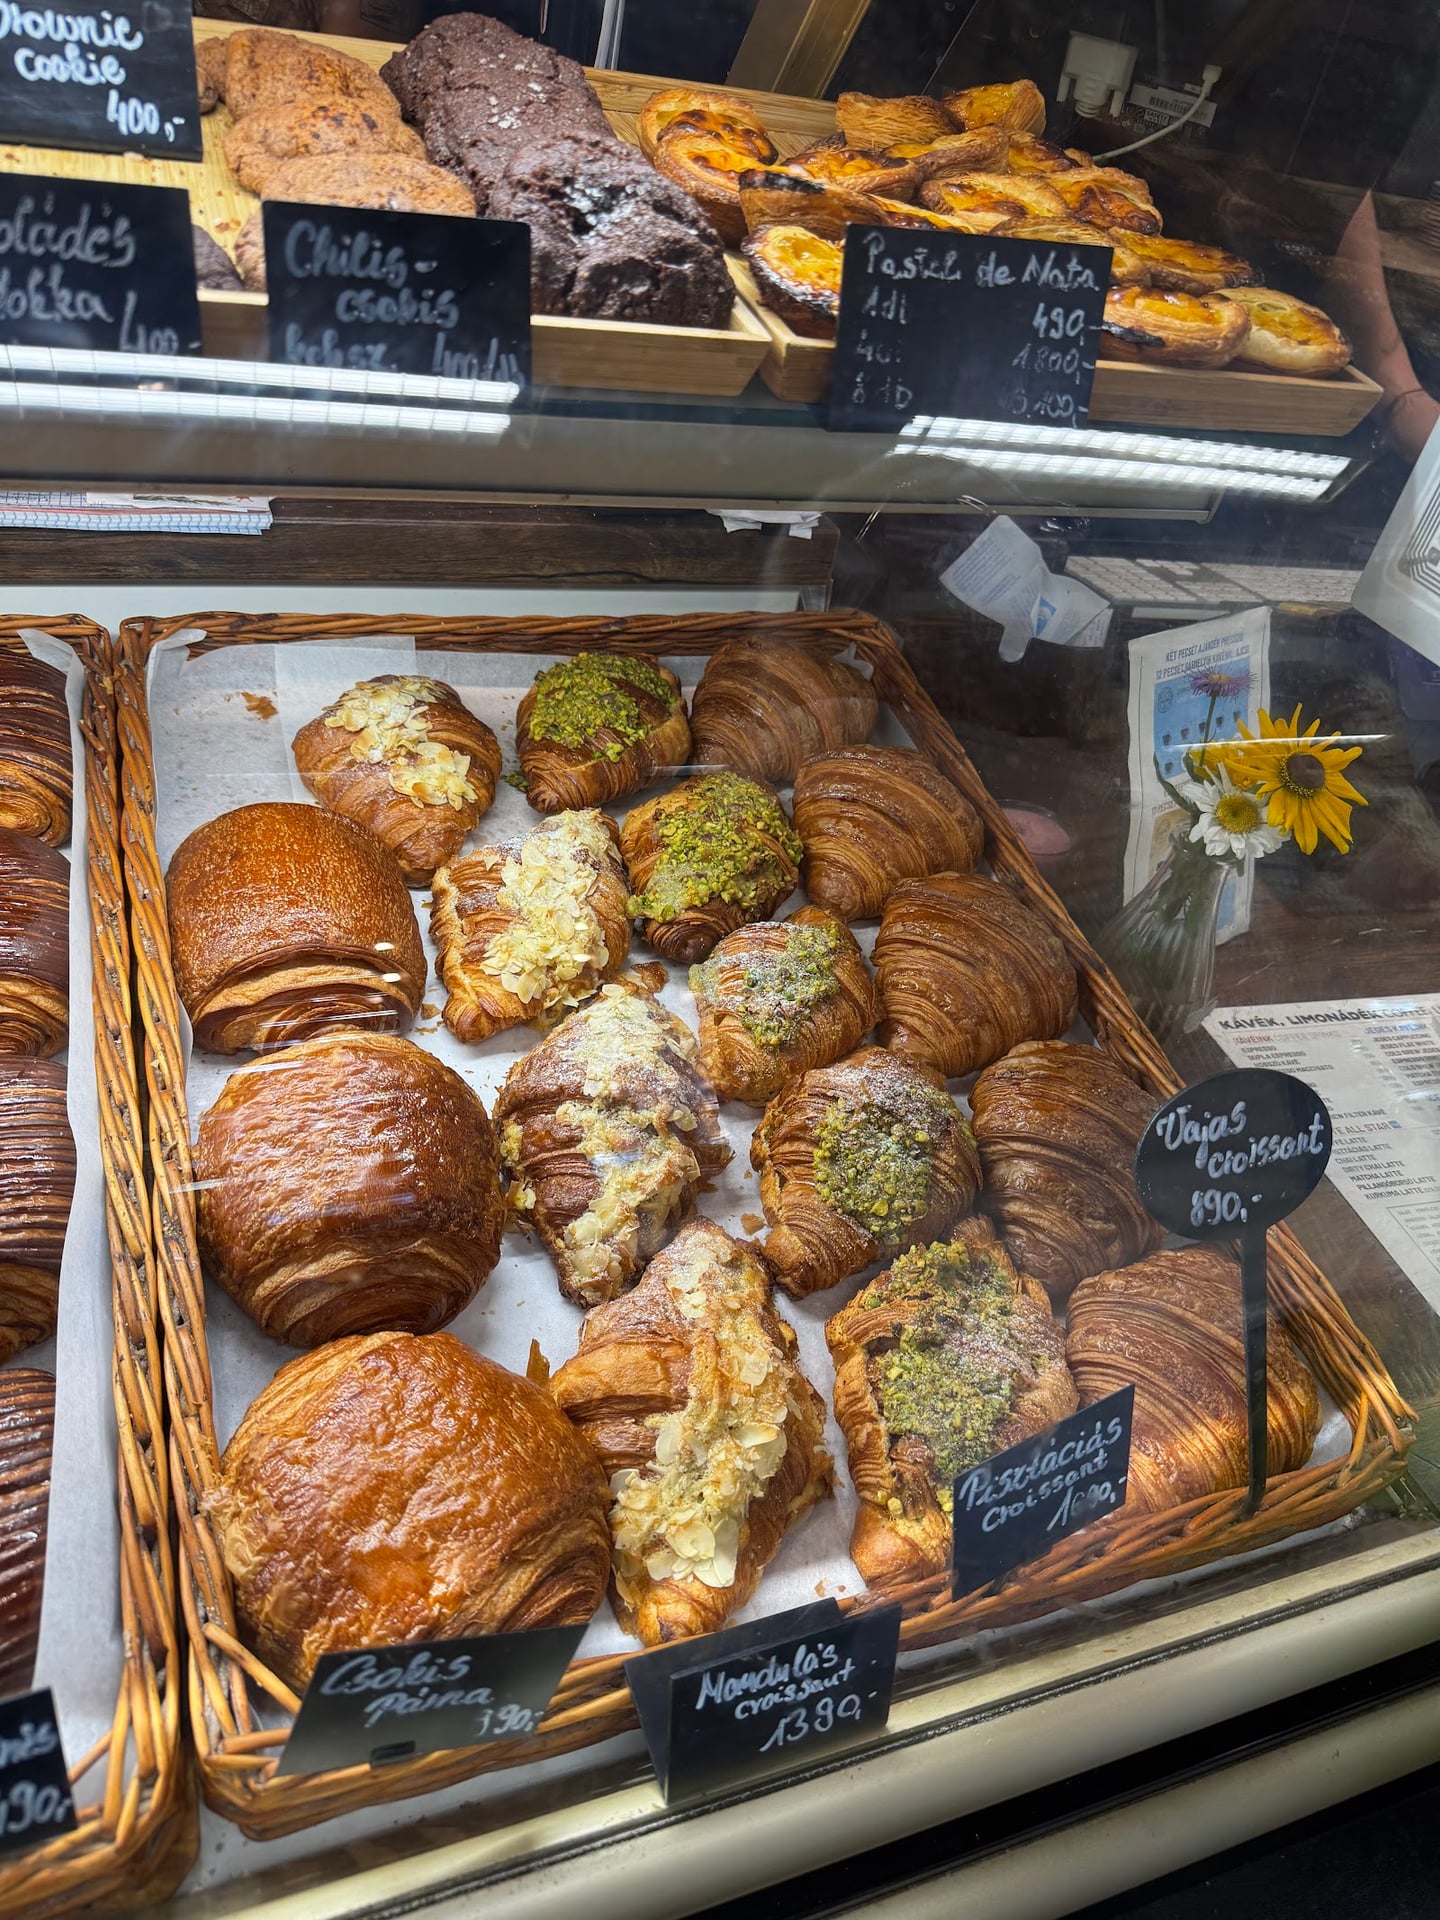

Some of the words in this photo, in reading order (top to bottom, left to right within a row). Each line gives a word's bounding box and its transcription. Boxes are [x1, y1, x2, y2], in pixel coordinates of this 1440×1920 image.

[975, 250, 1016, 288] de
[1218, 1013, 1285, 1030] KÁVÉK,
[1286, 1008, 1382, 1026] LIMONÁDÉK
[1155, 1101, 1247, 1169] Vajas
[1366, 1122, 1392, 1132] STAR
[1381, 1160, 1406, 1169] LATTE
[1349, 1172, 1380, 1182] MATCHA
[1380, 1170, 1404, 1179] LATTE
[1413, 1176, 1437, 1184] LATTE
[1400, 1186, 1425, 1196] LATTE
[1190, 1188, 1262, 1227] 890,-
[958, 1416, 1123, 1511] Pisztáciás
